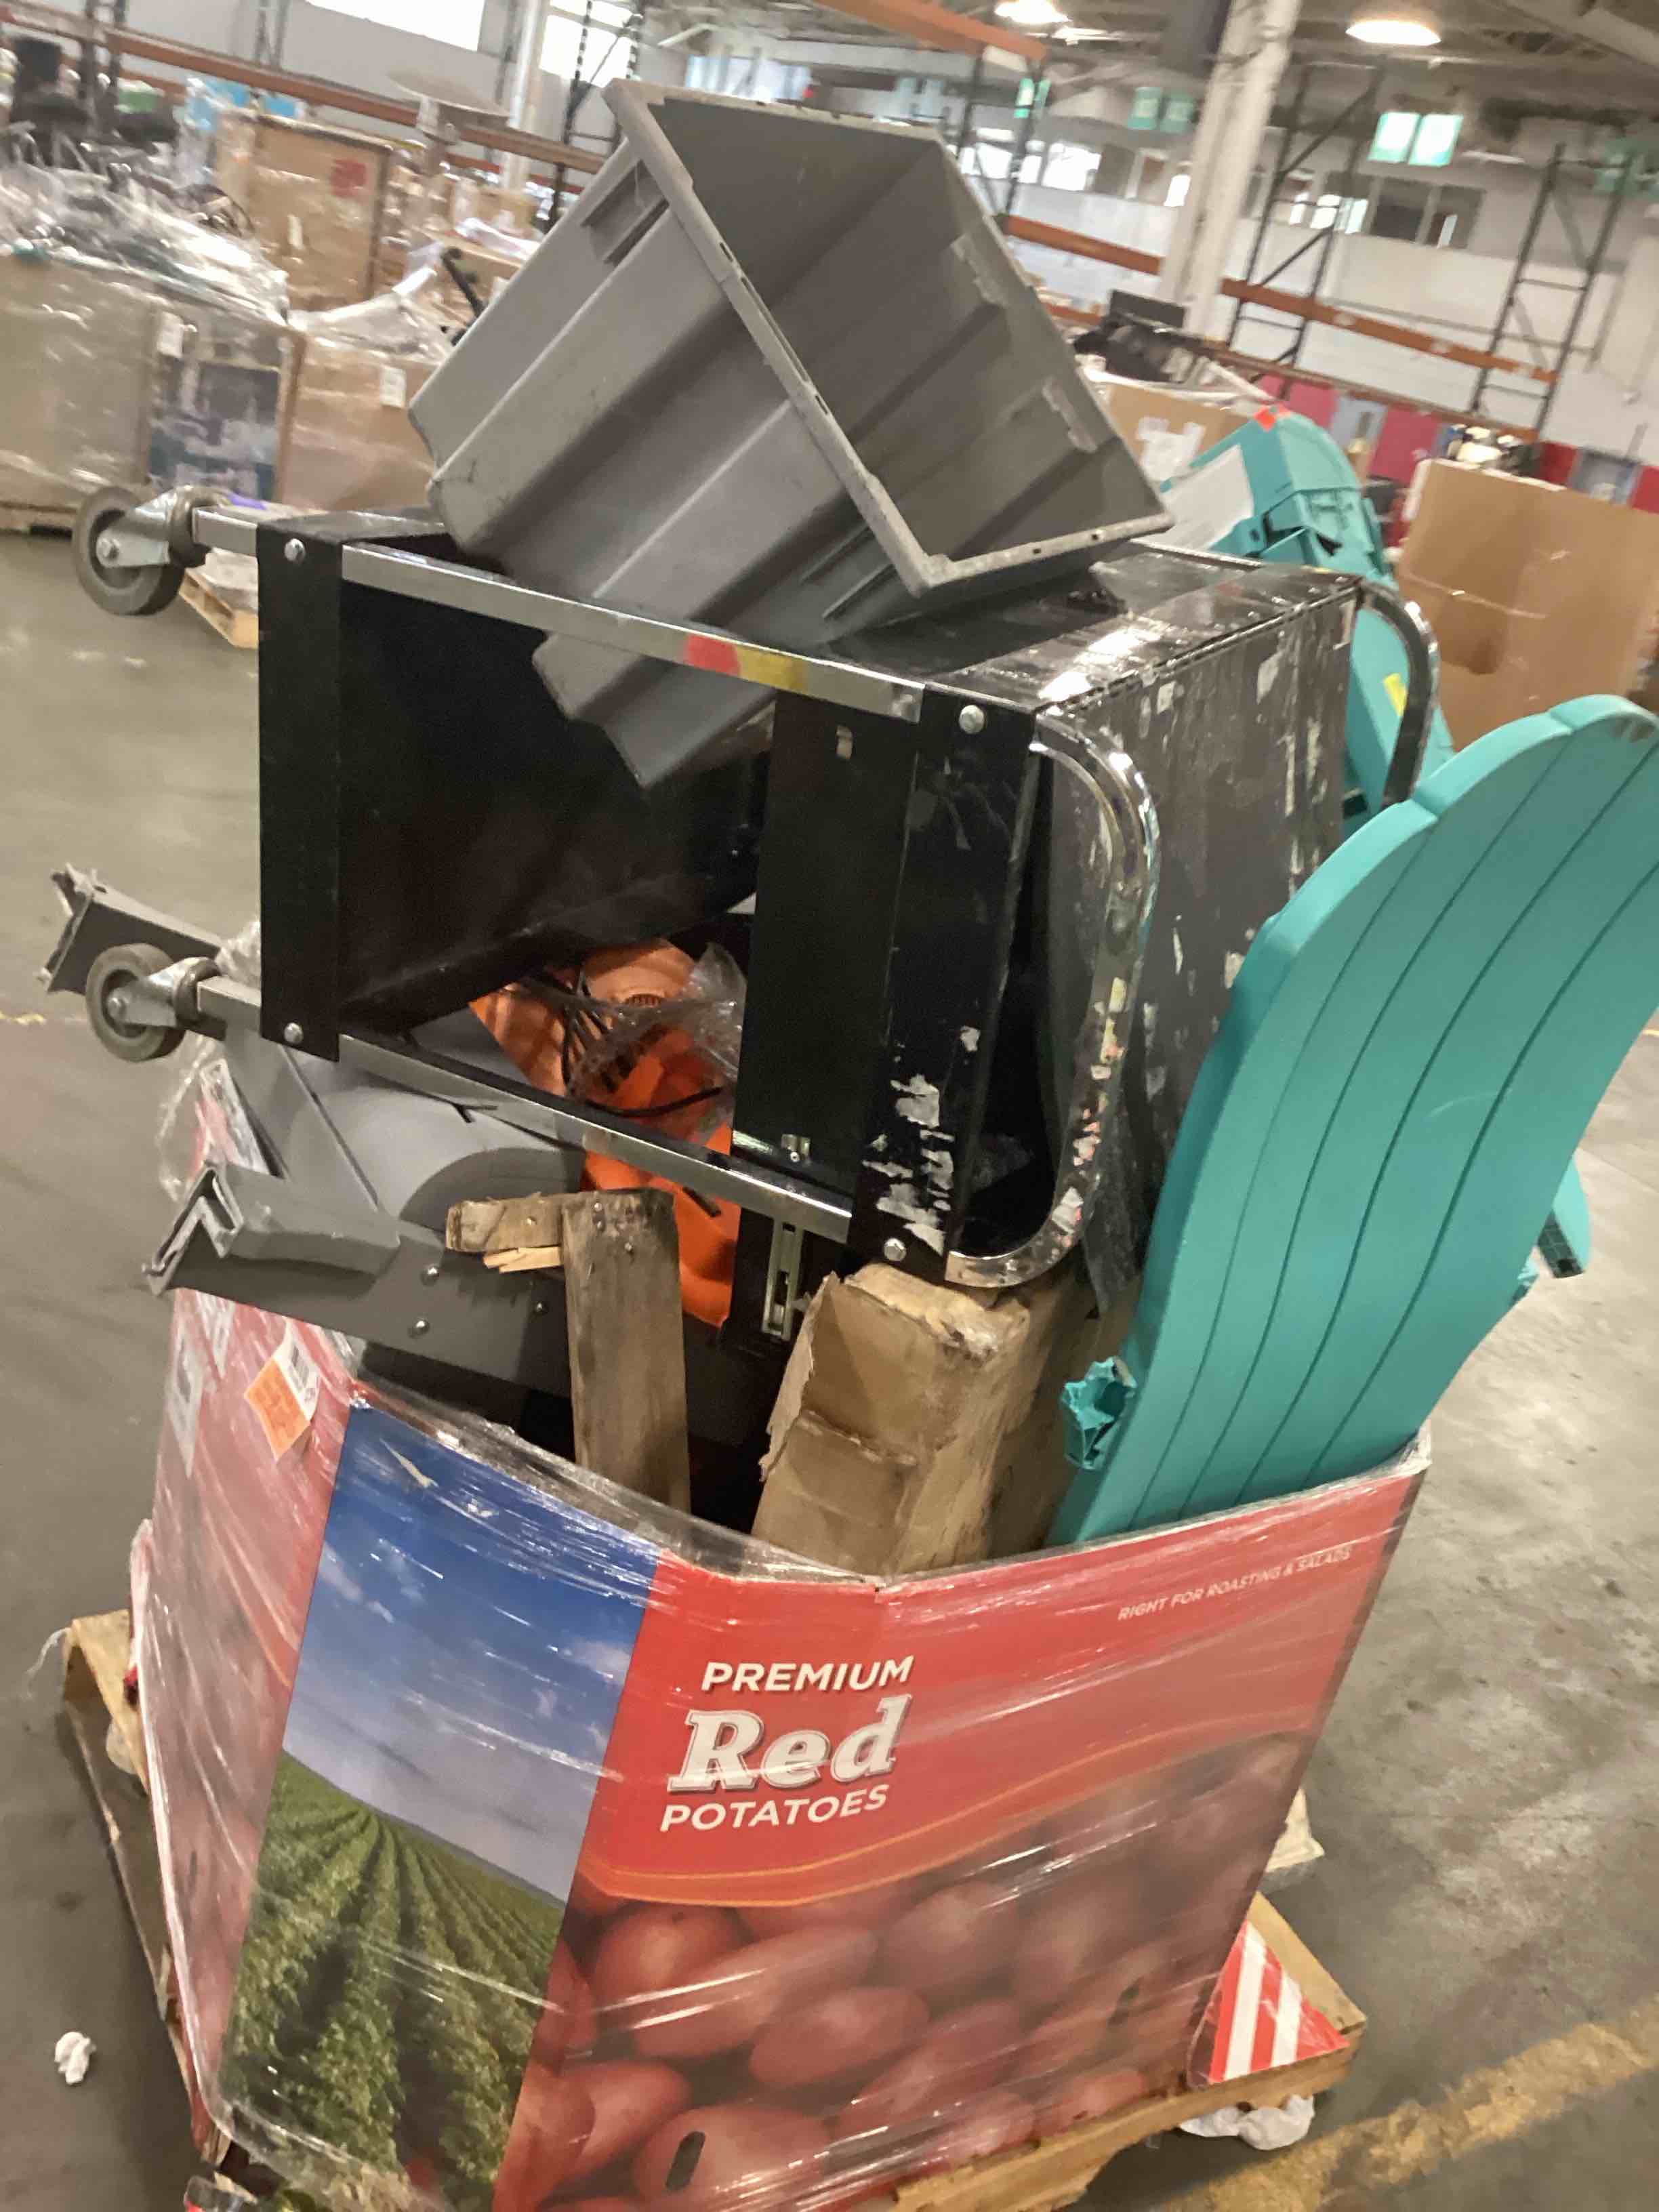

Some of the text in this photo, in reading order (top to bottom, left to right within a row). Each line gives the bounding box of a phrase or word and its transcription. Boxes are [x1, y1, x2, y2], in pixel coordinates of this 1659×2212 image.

[1118, 1596, 1169, 1621] RIGHT
[1170, 1588, 1204, 1610] FOR
[1206, 1566, 1282, 1598] ROASTING
[1295, 1544, 1353, 1572] SALADS
[701, 1655, 914, 1692] PREMIUM
[665, 1694, 914, 1795] Red
[659, 1784, 890, 1833] POTATOES
